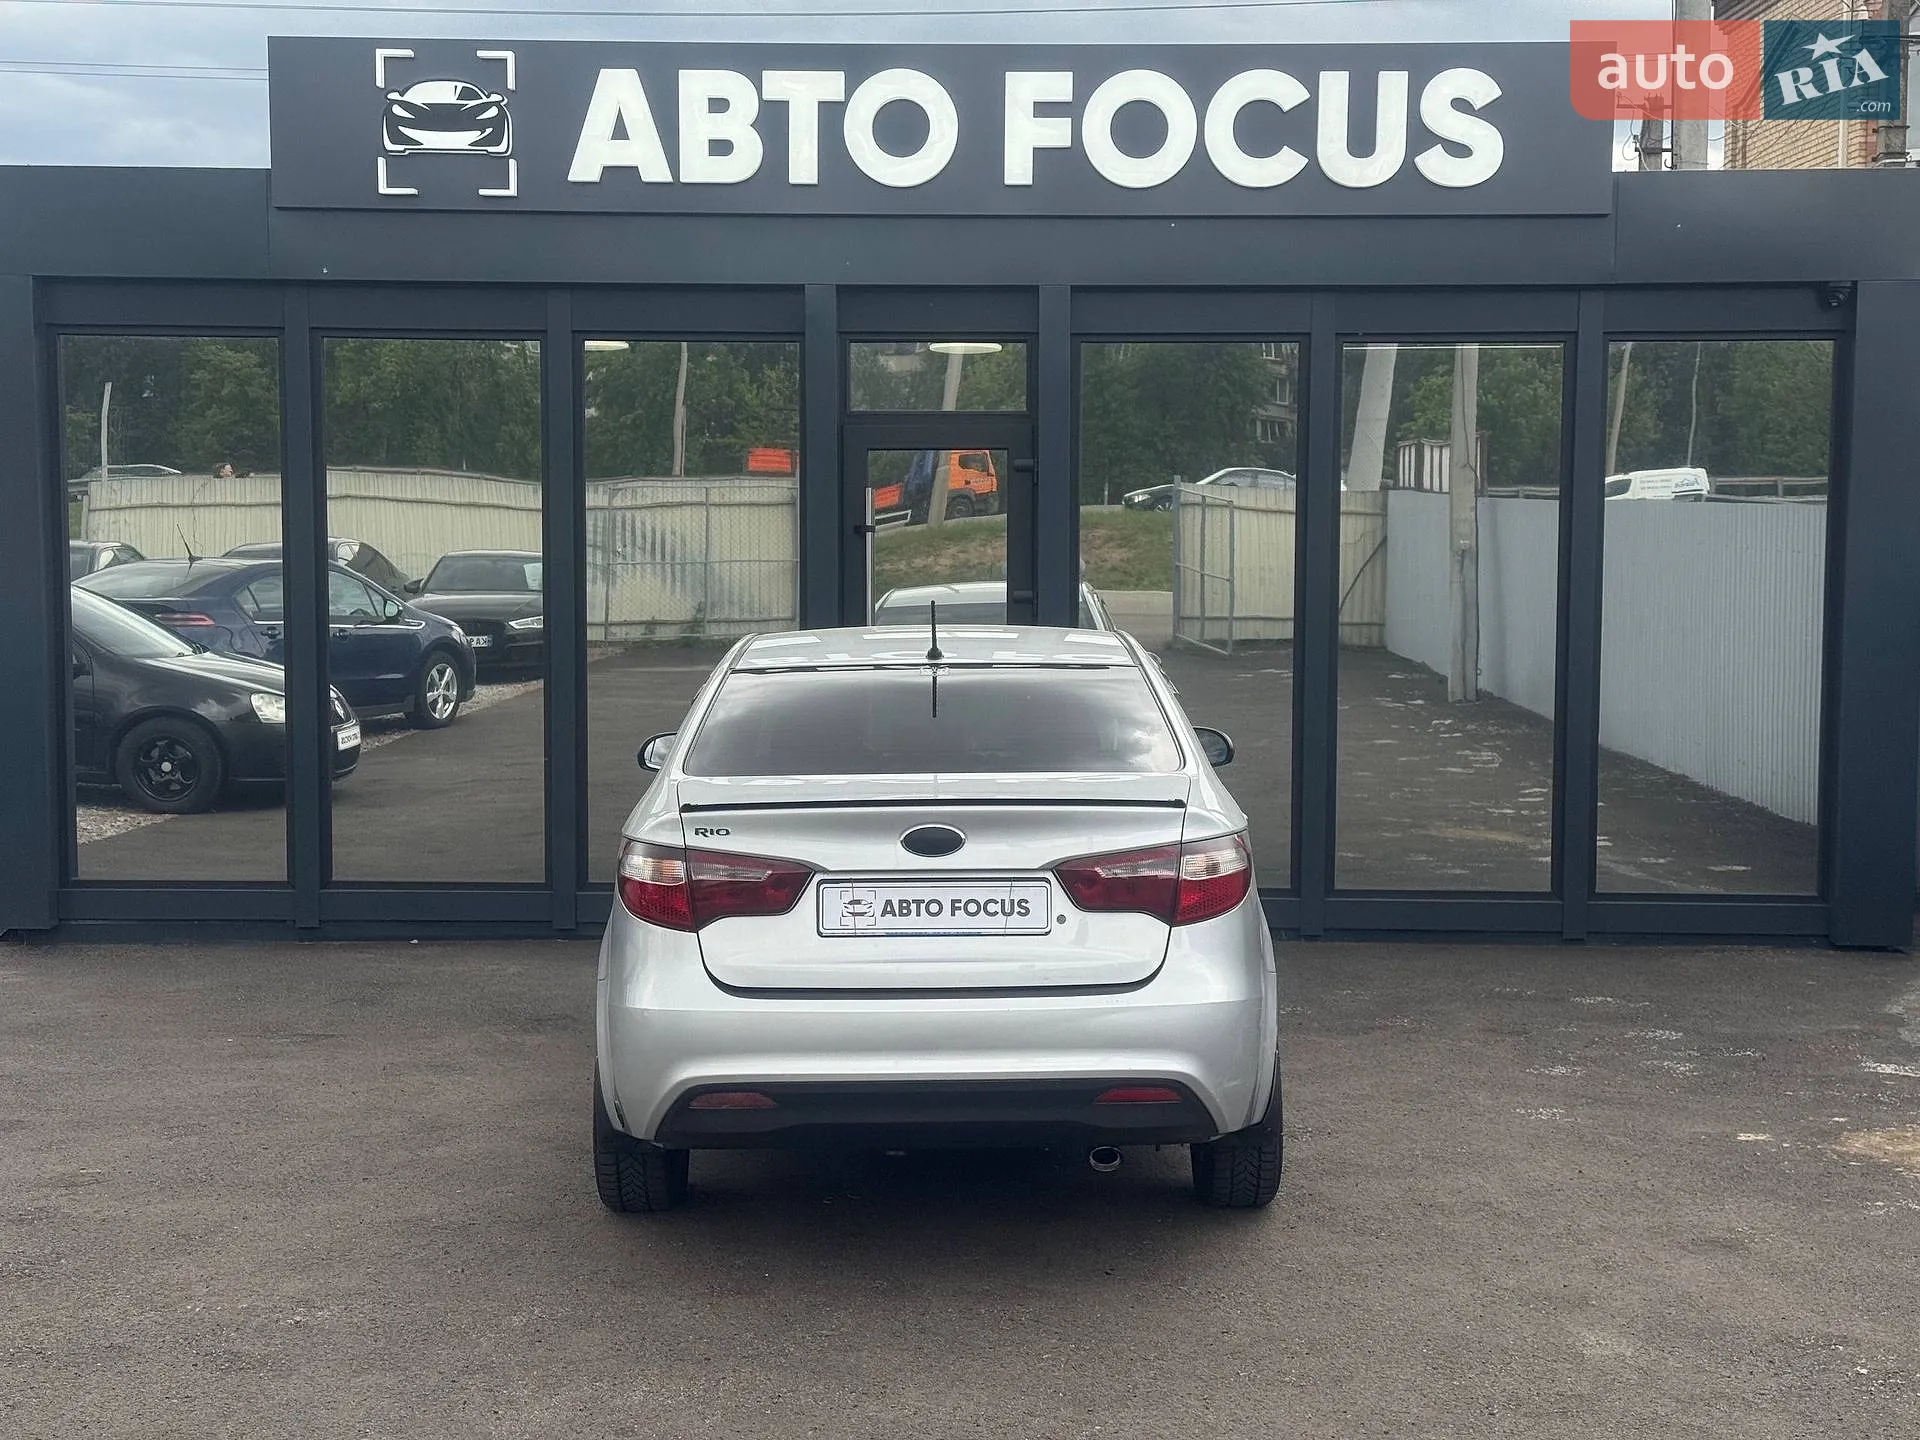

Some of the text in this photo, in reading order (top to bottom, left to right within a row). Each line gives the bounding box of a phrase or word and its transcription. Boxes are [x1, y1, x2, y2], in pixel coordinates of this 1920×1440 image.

[567, 67, 1504, 189] АВТО FOCUS
[694, 827, 731, 838] RIO
[880, 898, 1031, 917] АВТО FOCUS
